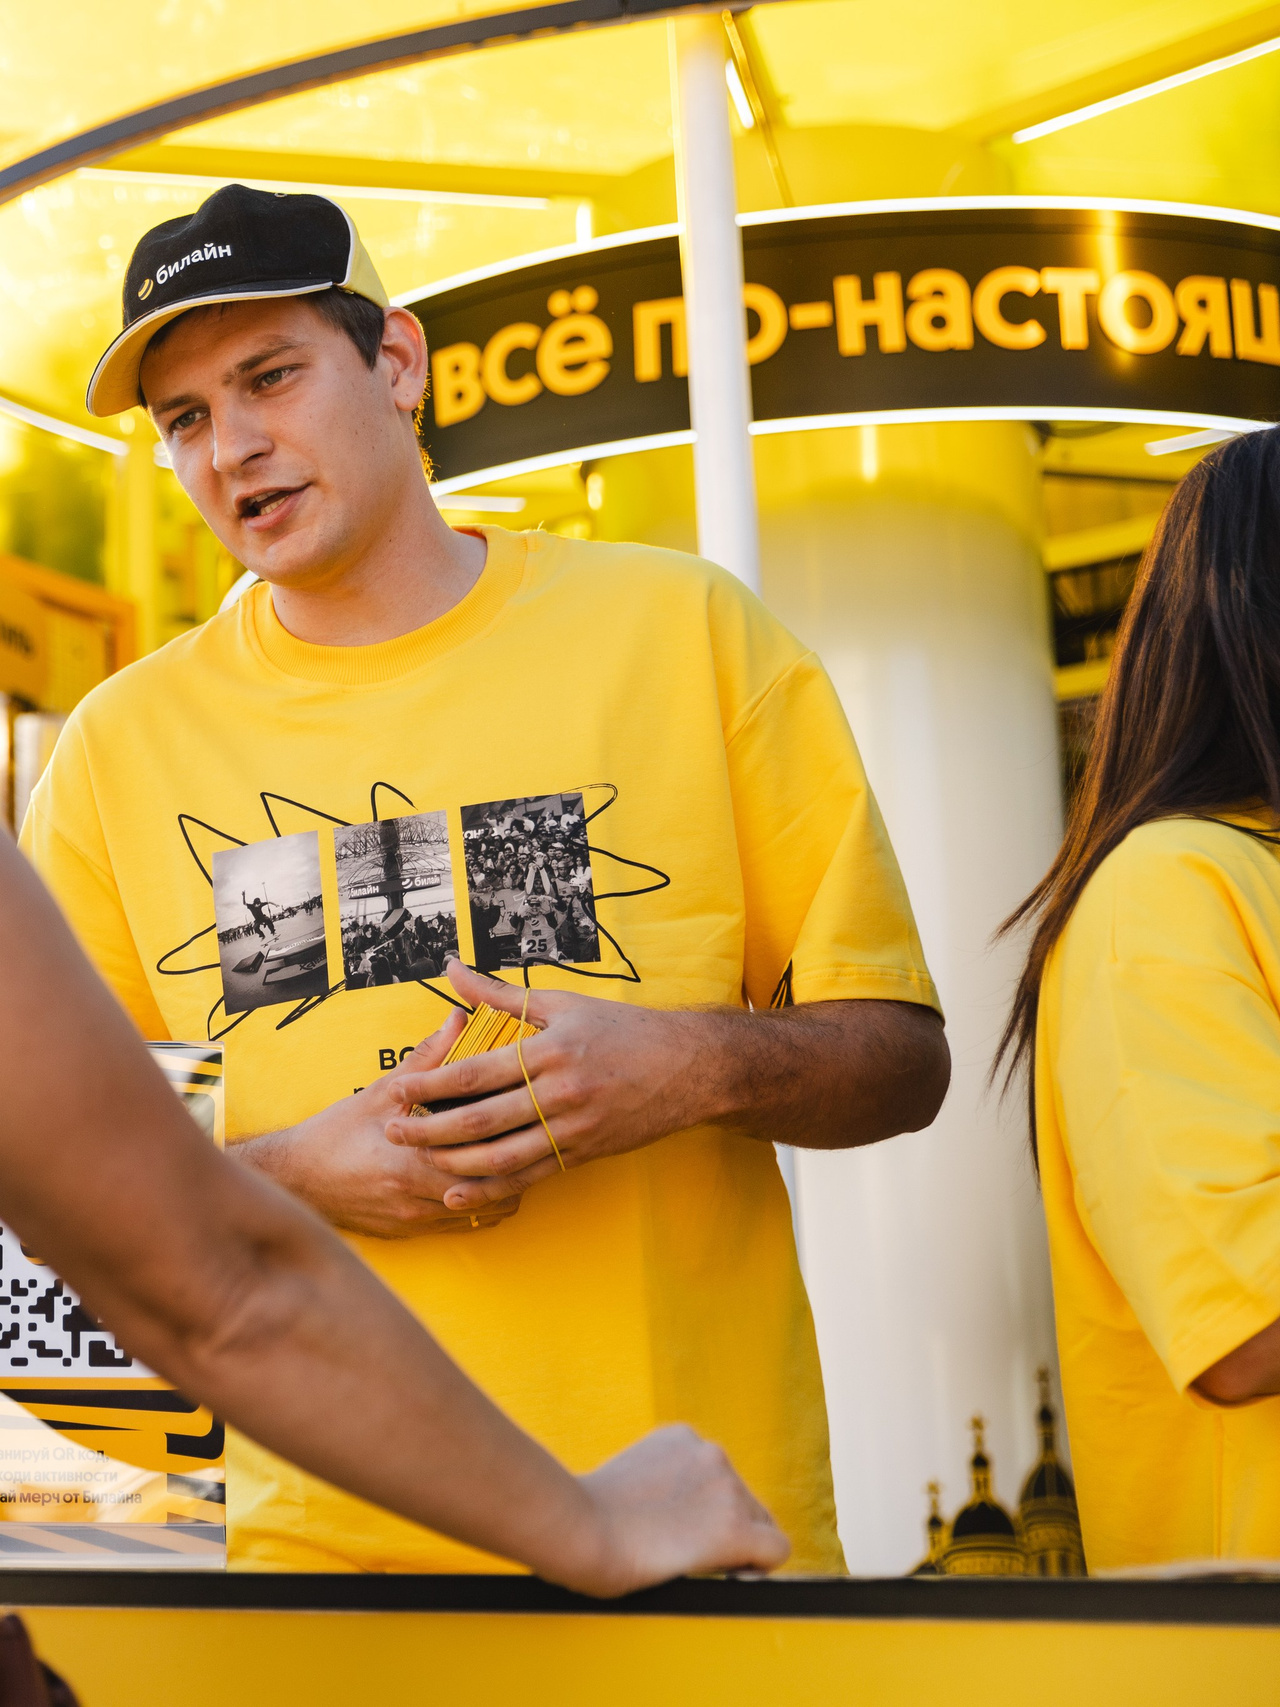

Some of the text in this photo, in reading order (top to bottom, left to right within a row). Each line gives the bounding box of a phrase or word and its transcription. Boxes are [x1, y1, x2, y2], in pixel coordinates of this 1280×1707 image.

[156, 243, 232, 285] билайн
[431, 285, 613, 429] всё
[526, 938, 548, 954] 25
[52, 1446, 75, 1462] QR
[78, 1449, 110, 1464] код,
[34, 1470, 118, 1483] активности
[19, 1491, 60, 1506] мерч
[63, 1491, 80, 1504] от
[83, 1489, 142, 1504] Билайна
